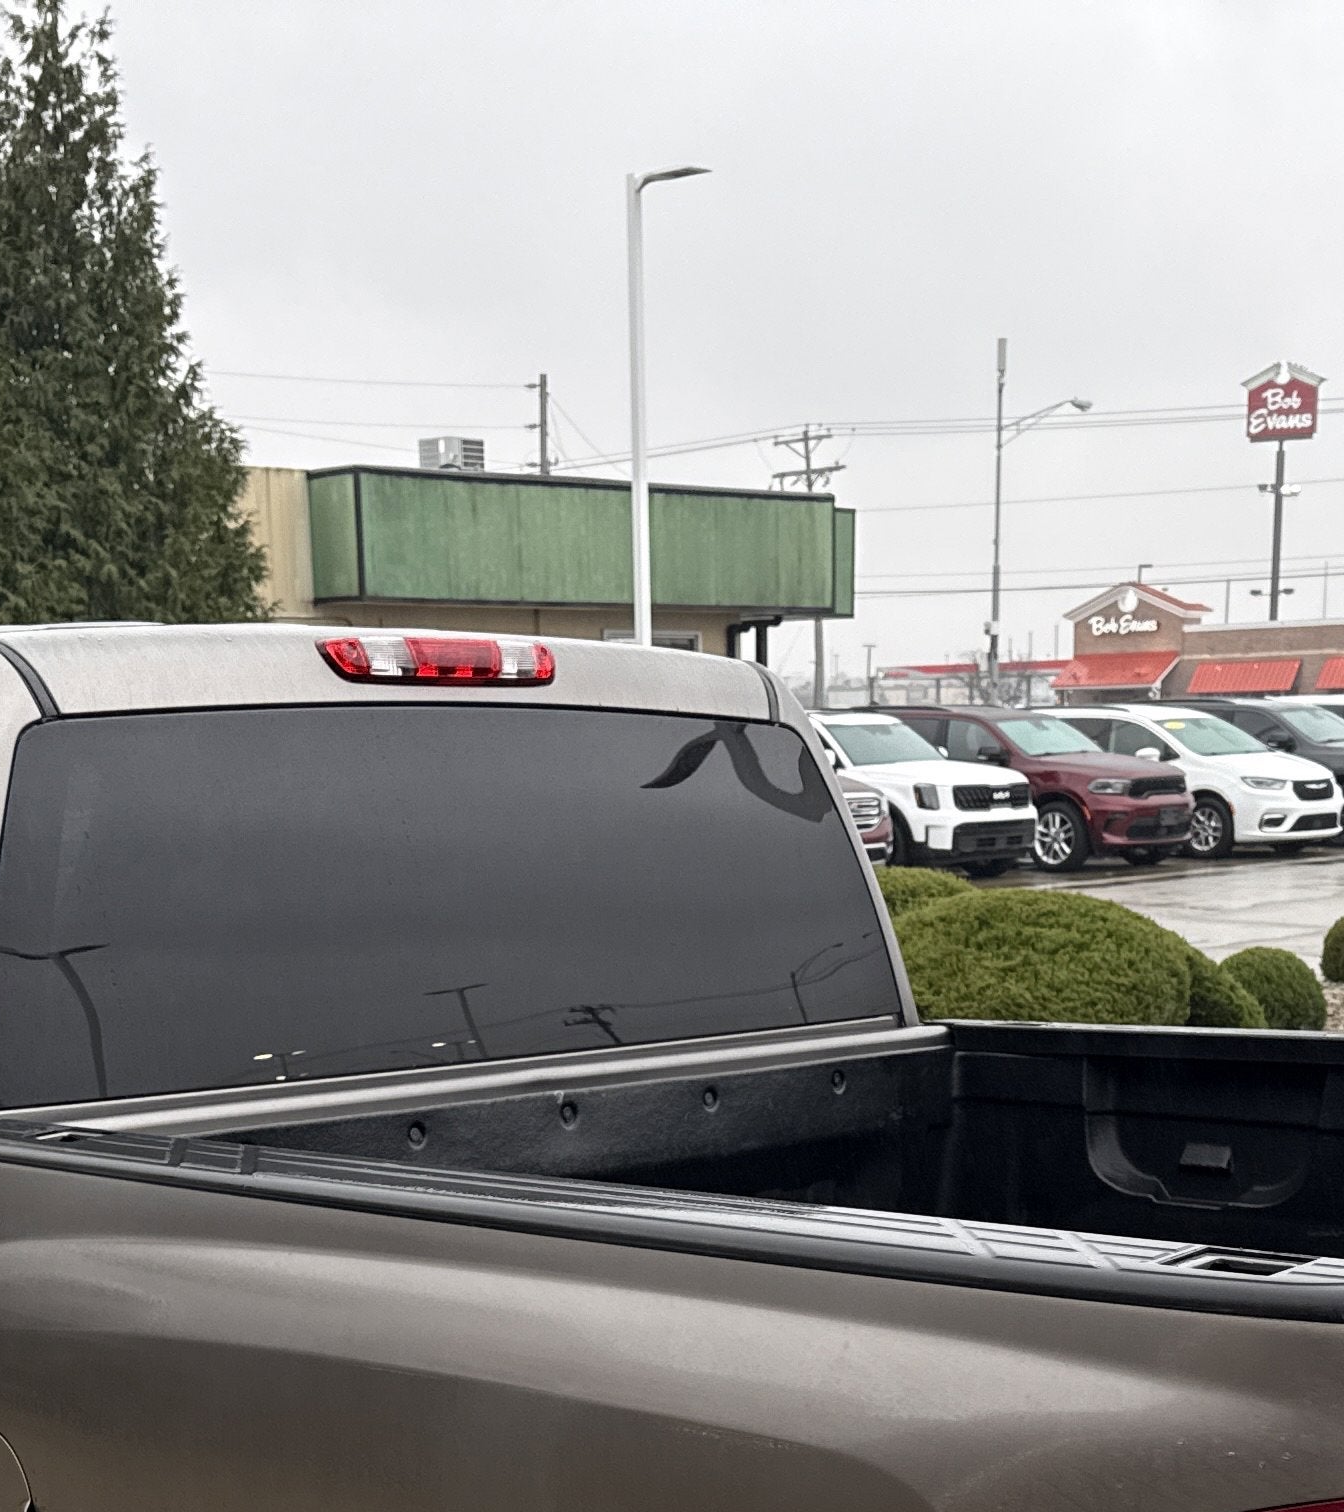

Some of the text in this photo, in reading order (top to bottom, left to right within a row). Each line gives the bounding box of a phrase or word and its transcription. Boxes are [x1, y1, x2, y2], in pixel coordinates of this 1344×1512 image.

[1261, 388, 1302, 411] Bob
[1249, 408, 1313, 434] Evans
[1088, 616, 1118, 636] Bob
